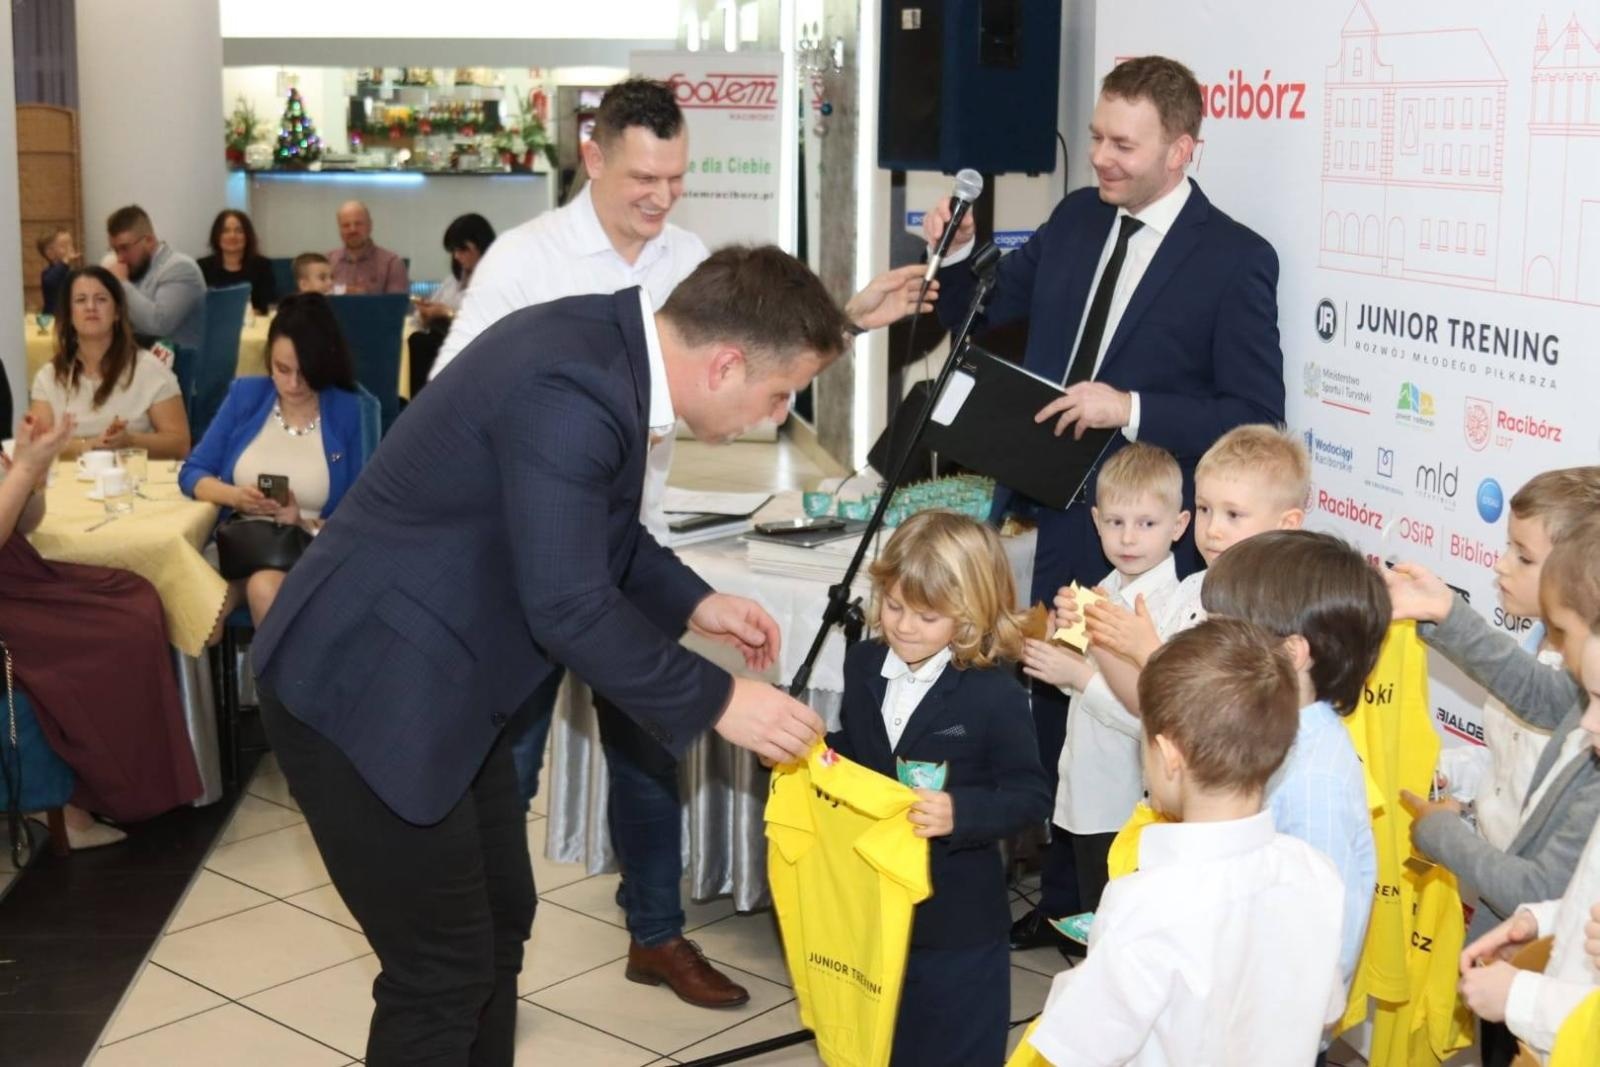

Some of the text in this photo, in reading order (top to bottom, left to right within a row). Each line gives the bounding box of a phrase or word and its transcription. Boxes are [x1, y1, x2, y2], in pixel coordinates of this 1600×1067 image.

[1200, 69, 1306, 120] cibórz
[702, 157, 722, 174] dla
[728, 157, 771, 174] Ciebie
[1356, 304, 1438, 344] JUNIOR
[1447, 318, 1559, 366] TRENING
[1355, 342, 1557, 389] ROZWÓJ MŁODEGO PIŁKARZA
[1497, 410, 1562, 442] Racibórz
[1416, 461, 1459, 498] mld
[1318, 489, 1383, 530] Racibórz
[1399, 516, 1434, 547] OSiR
[1450, 533, 1499, 568] Bibliot
[809, 951, 849, 976] JUNIOR
